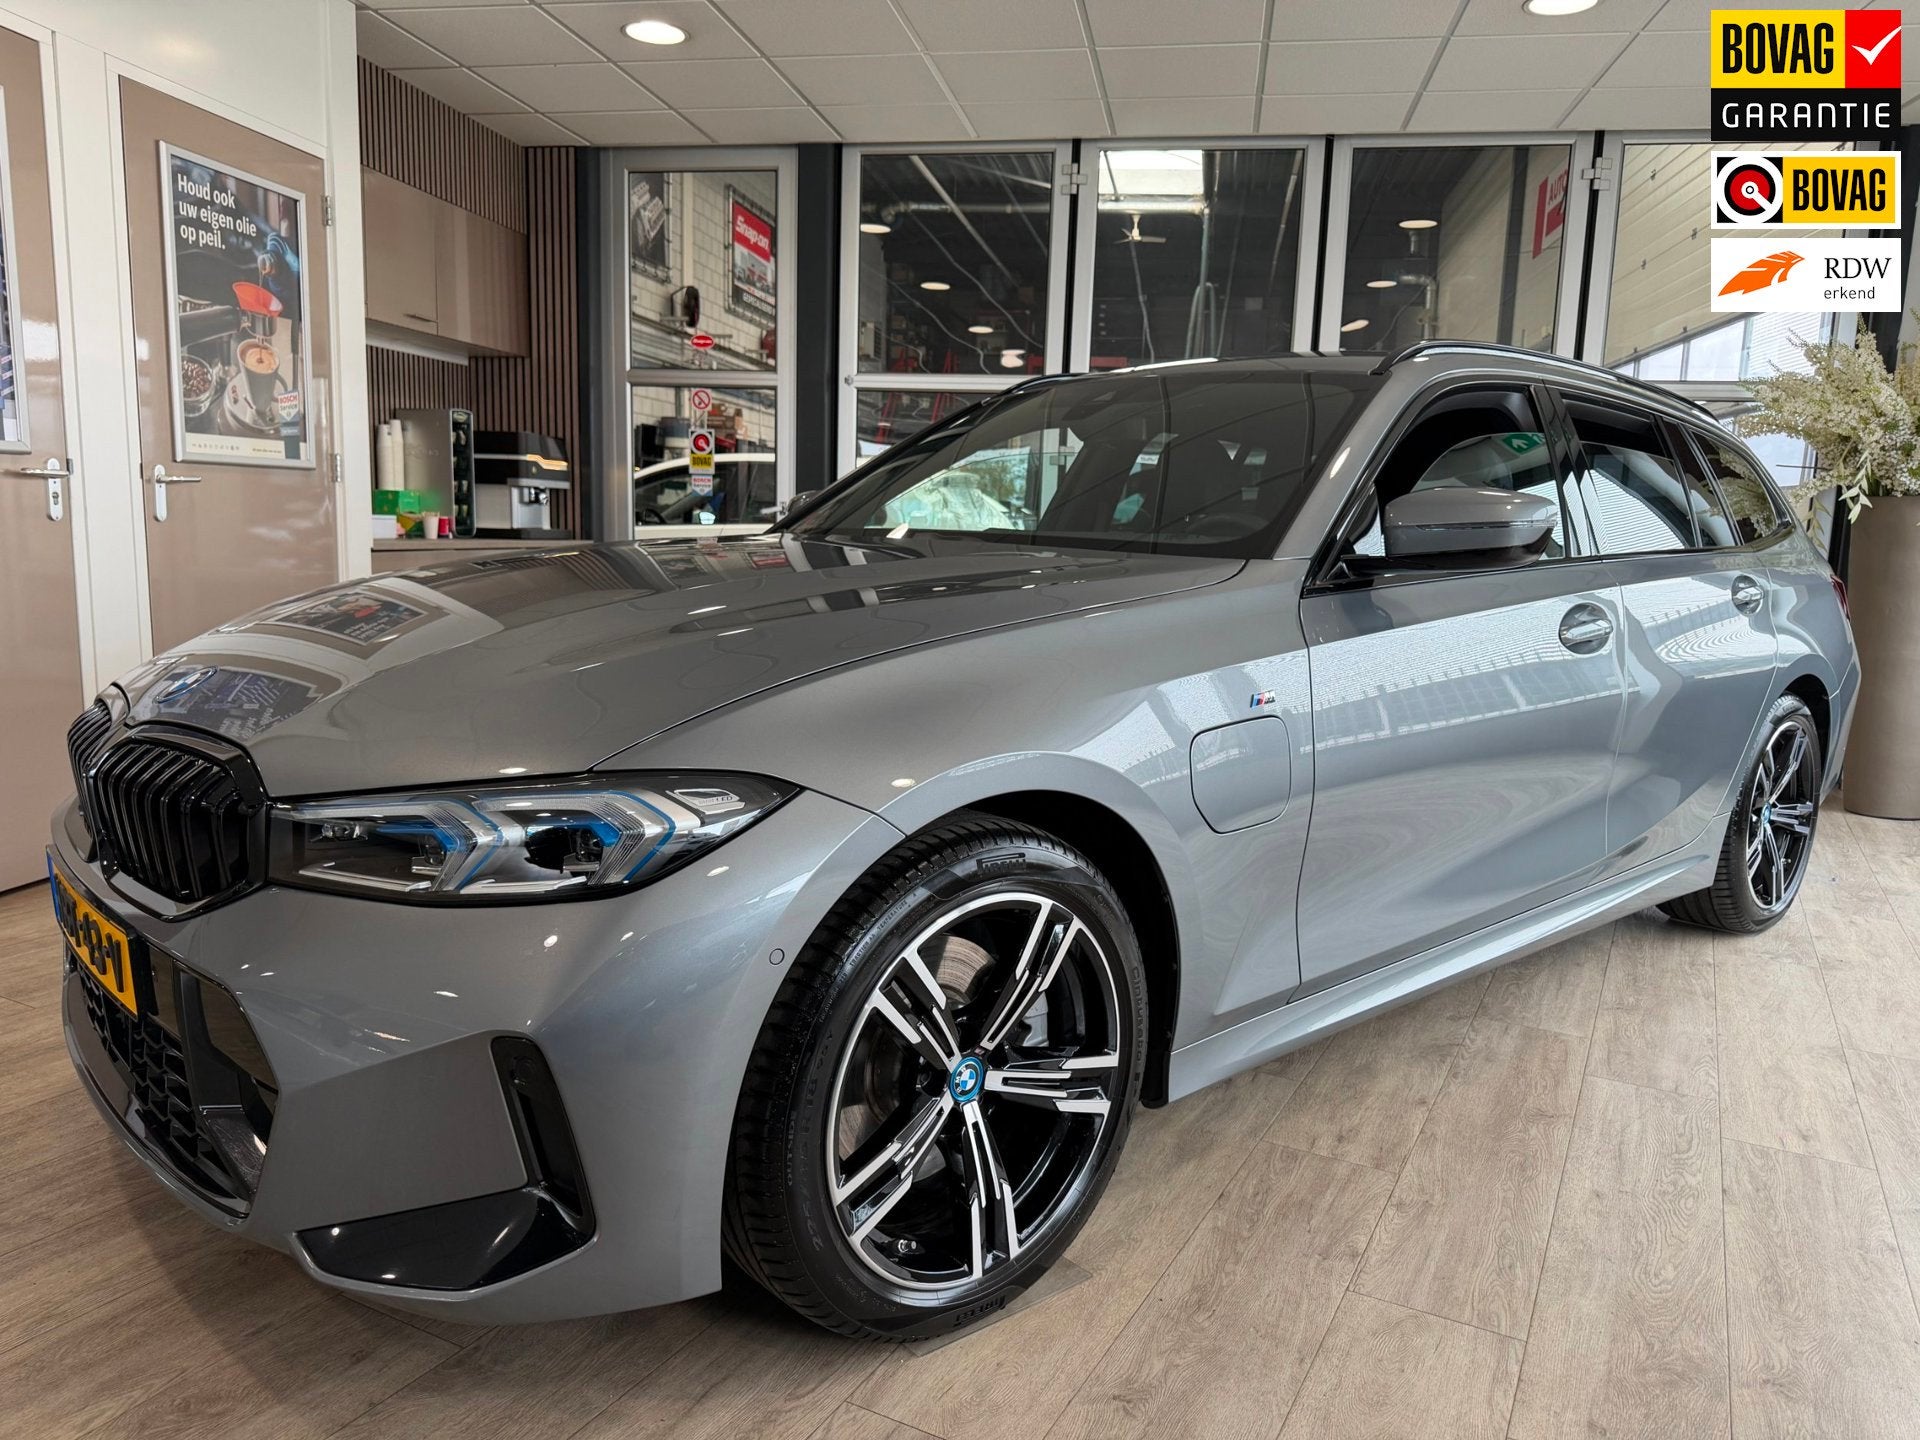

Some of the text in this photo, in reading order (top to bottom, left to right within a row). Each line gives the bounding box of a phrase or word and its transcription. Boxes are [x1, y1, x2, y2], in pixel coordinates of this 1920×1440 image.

[177, 173, 236, 209] Houd ook
[179, 201, 257, 237] uw eigen olie
[735, 216, 769, 250] Snap-on
[180, 225, 226, 250] op peil.
[692, 456, 711, 466] BOVAG
